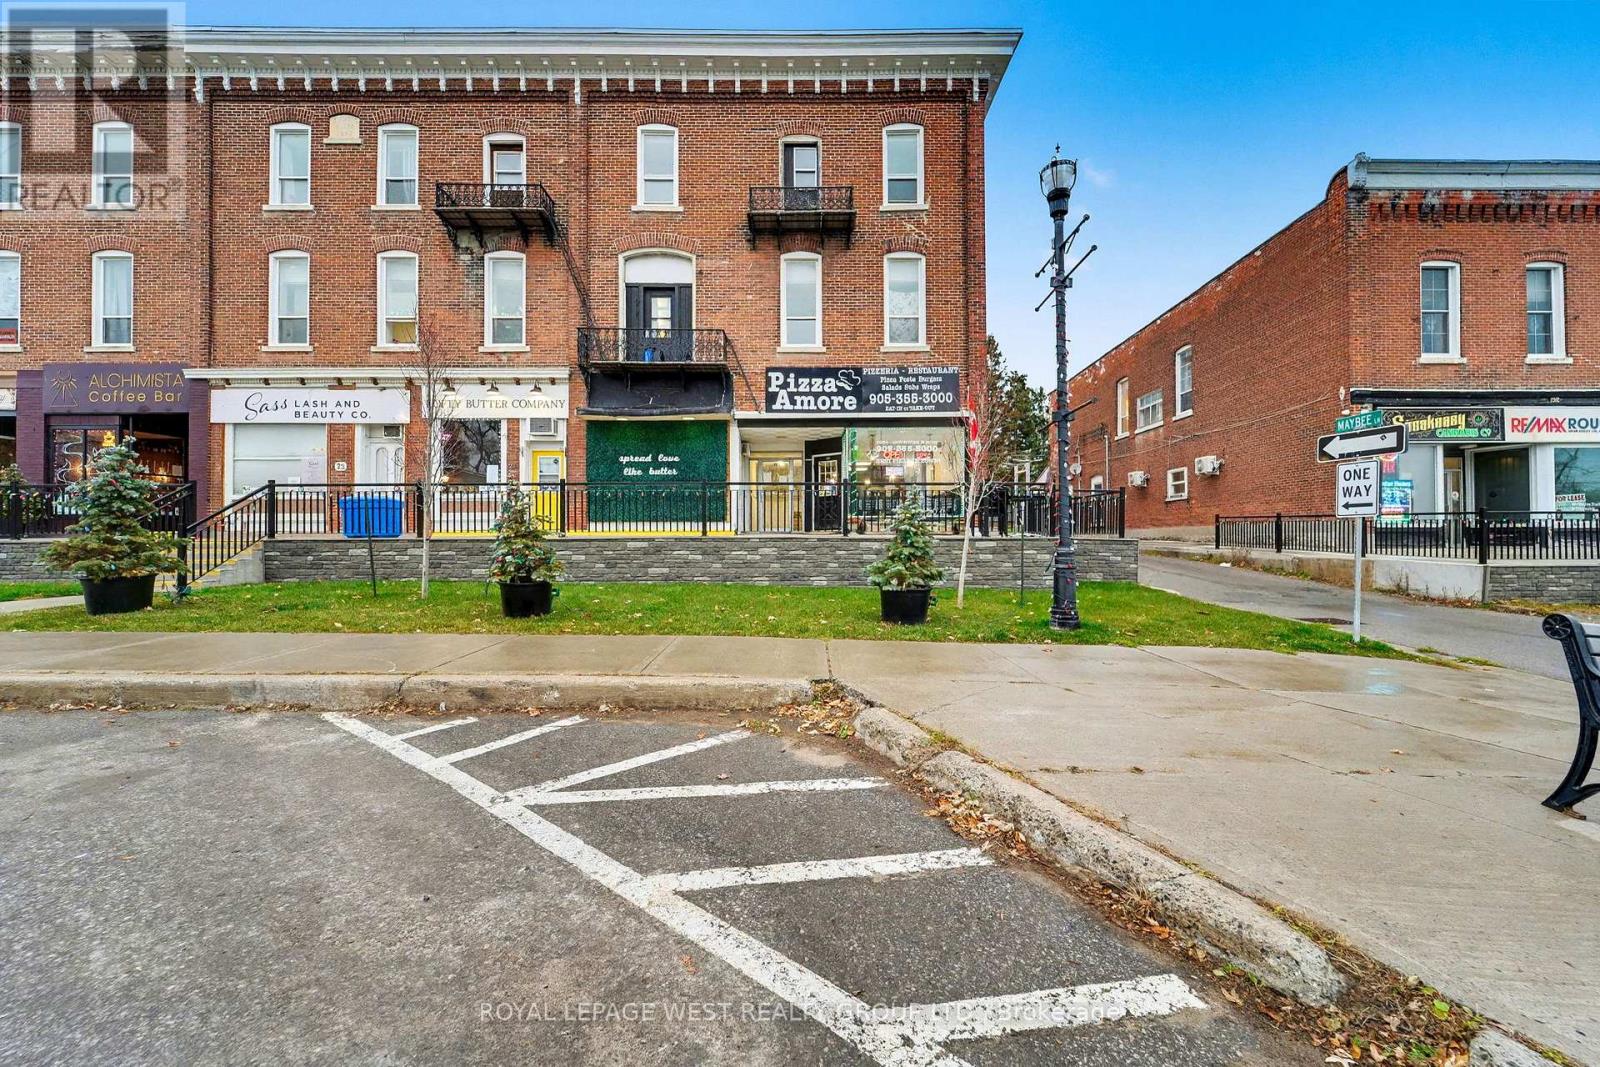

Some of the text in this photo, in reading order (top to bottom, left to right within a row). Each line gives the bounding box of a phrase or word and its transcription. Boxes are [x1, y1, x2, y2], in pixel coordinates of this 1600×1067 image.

[863, 367, 900, 375] PIZZERIA
[908, 366, 959, 375] RESTAURANT
[88, 373, 184, 388] ALCHIMISTA
[768, 372, 838, 392] Pizza
[88, 389, 182, 402] Coffee Bar
[772, 389, 857, 411] Amore
[244, 391, 288, 421] Sass
[294, 400, 360, 408] LASH AND
[466, 399, 508, 409] BUTTER
[511, 399, 566, 409] COMPANY
[294, 410, 371, 419] BEAUTY CO.
[1337, 414, 1372, 431] MAYBEE
[1511, 416, 1567, 433] RE/MAX
[619, 454, 680, 465] spread love
[623, 467, 678, 476] like butter
[1343, 467, 1371, 482] ONE
[1342, 484, 1373, 499] WAY
[1567, 494, 1585, 502] LEASE
